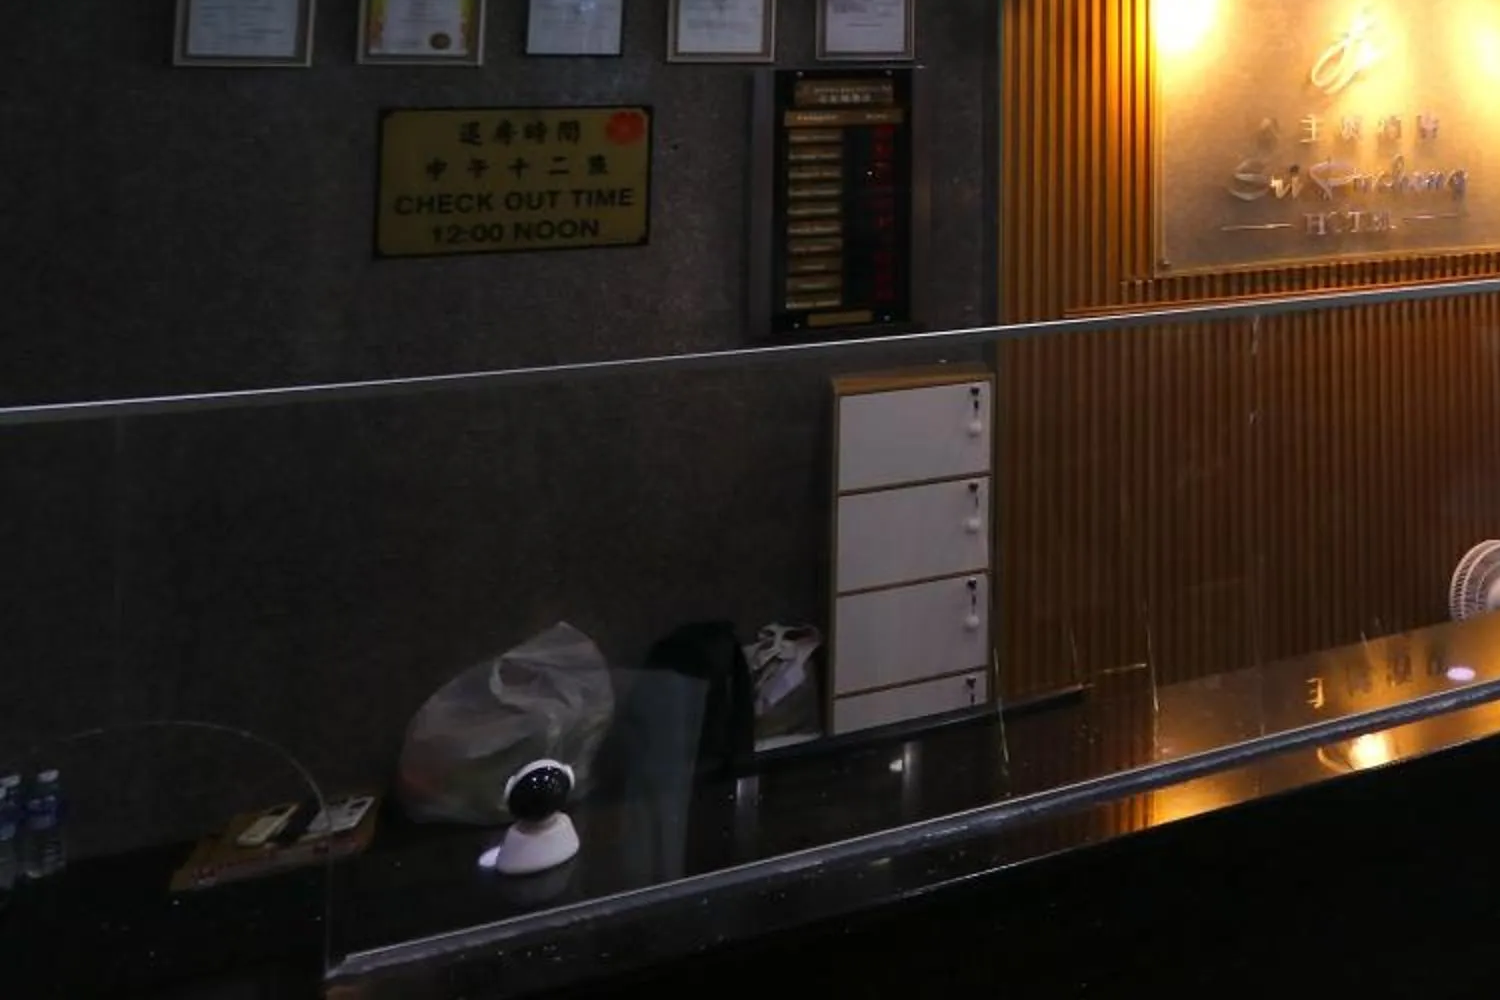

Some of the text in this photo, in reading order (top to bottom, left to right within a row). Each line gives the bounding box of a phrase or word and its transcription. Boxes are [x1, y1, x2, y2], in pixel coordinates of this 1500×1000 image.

[394, 188, 634, 215] CHECK OUT TIME
[432, 219, 599, 244] 12:00 NOON
